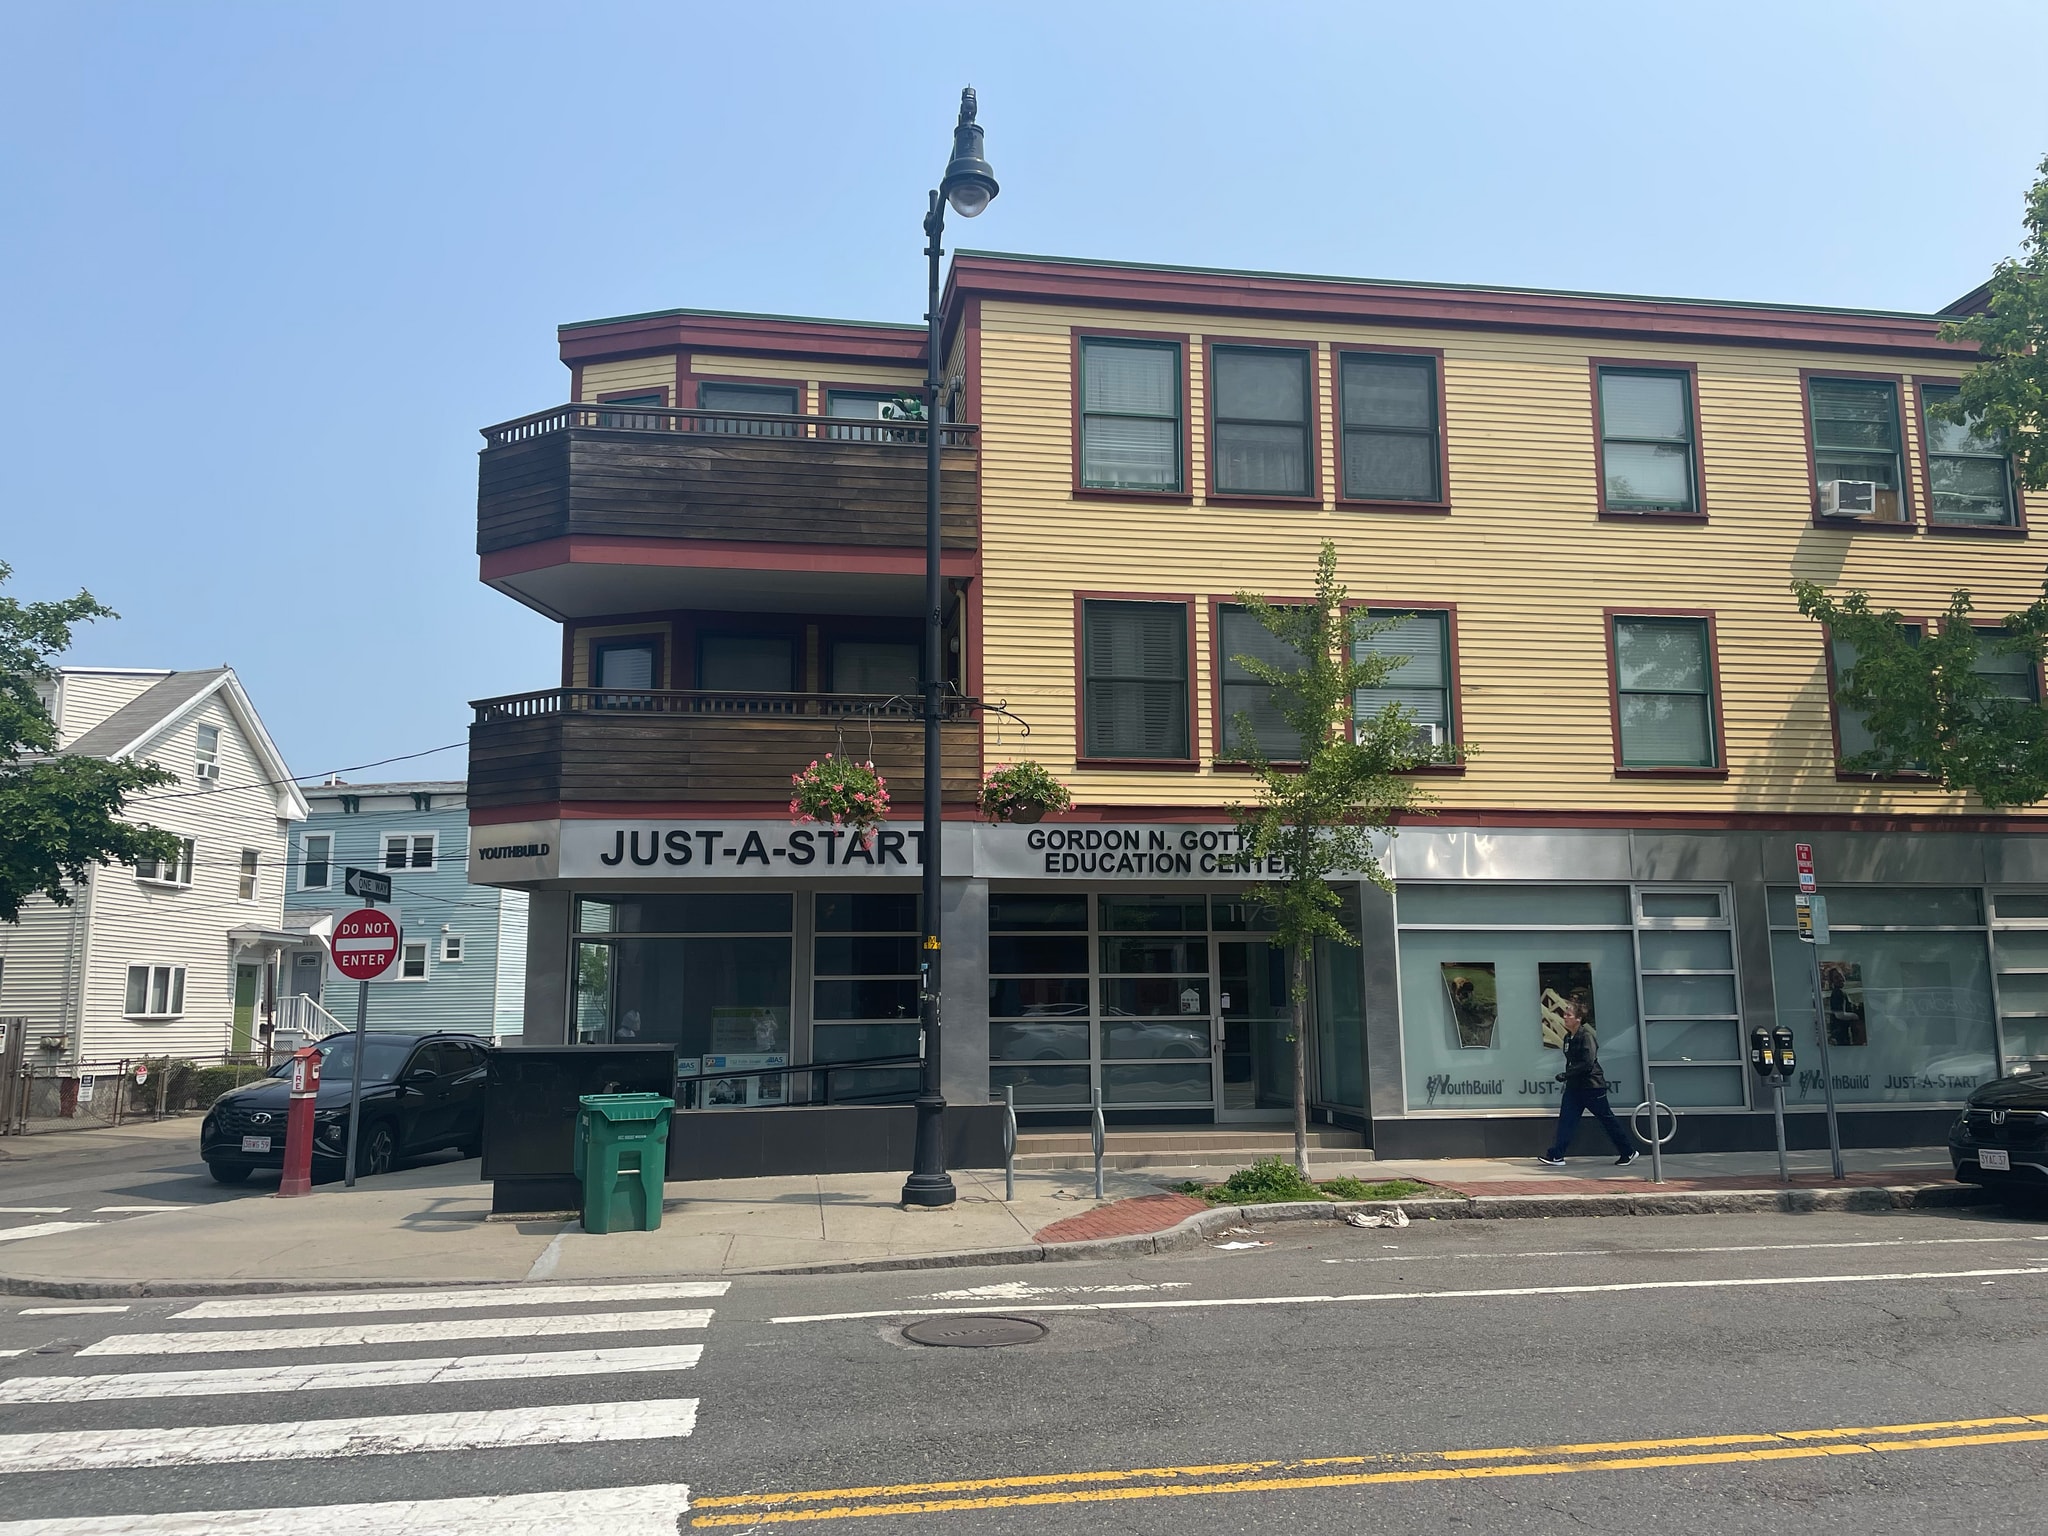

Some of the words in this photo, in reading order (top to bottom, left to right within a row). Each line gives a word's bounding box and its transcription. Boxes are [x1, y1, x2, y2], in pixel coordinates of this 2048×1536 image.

[601, 830, 924, 866] JUST-A-START
[1027, 830, 1140, 850] GORDON
[1149, 831, 1172, 850] N.
[479, 844, 550, 860] YOUTHBUILD
[1045, 853, 1191, 873] EDUCATION
[359, 878, 372, 891] ONE
[375, 881, 388, 895] WAY
[342, 924, 359, 935] DO
[365, 923, 390, 934] NOT
[342, 954, 385, 966] ENTER
[295, 1060, 303, 1090] FIRE
[1434, 1074, 1503, 1095] YouthBuild
[1804, 1069, 1870, 1089] YothBuild
[1885, 1074, 1978, 1089] JUST-A-START
